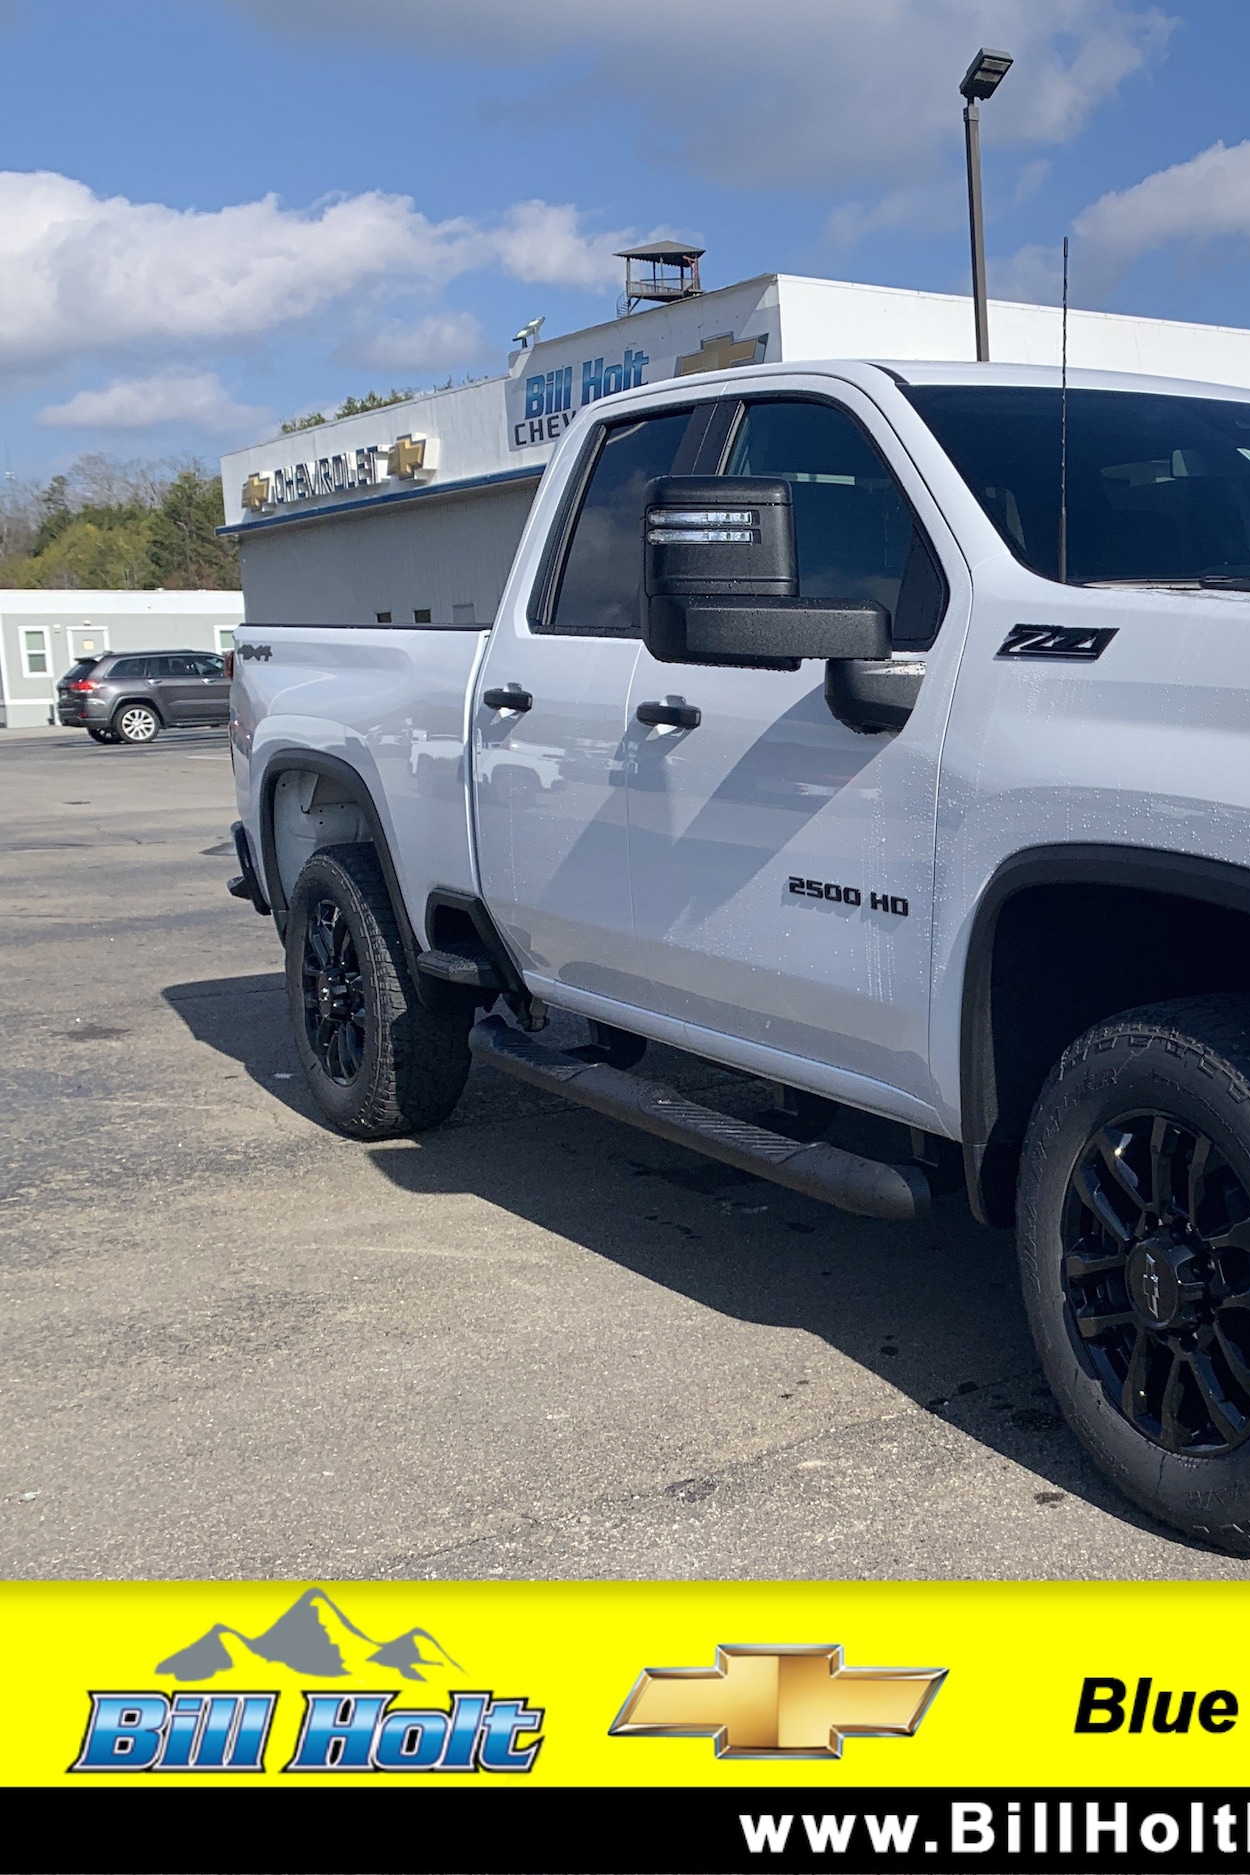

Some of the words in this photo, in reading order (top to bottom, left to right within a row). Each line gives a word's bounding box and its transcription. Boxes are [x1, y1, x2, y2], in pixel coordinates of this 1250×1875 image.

[524, 366, 573, 420] Bill
[581, 350, 649, 406] Holt
[273, 445, 385, 504] CHEVROLET
[789, 876, 861, 906] 2500
[870, 891, 909, 917] HD
